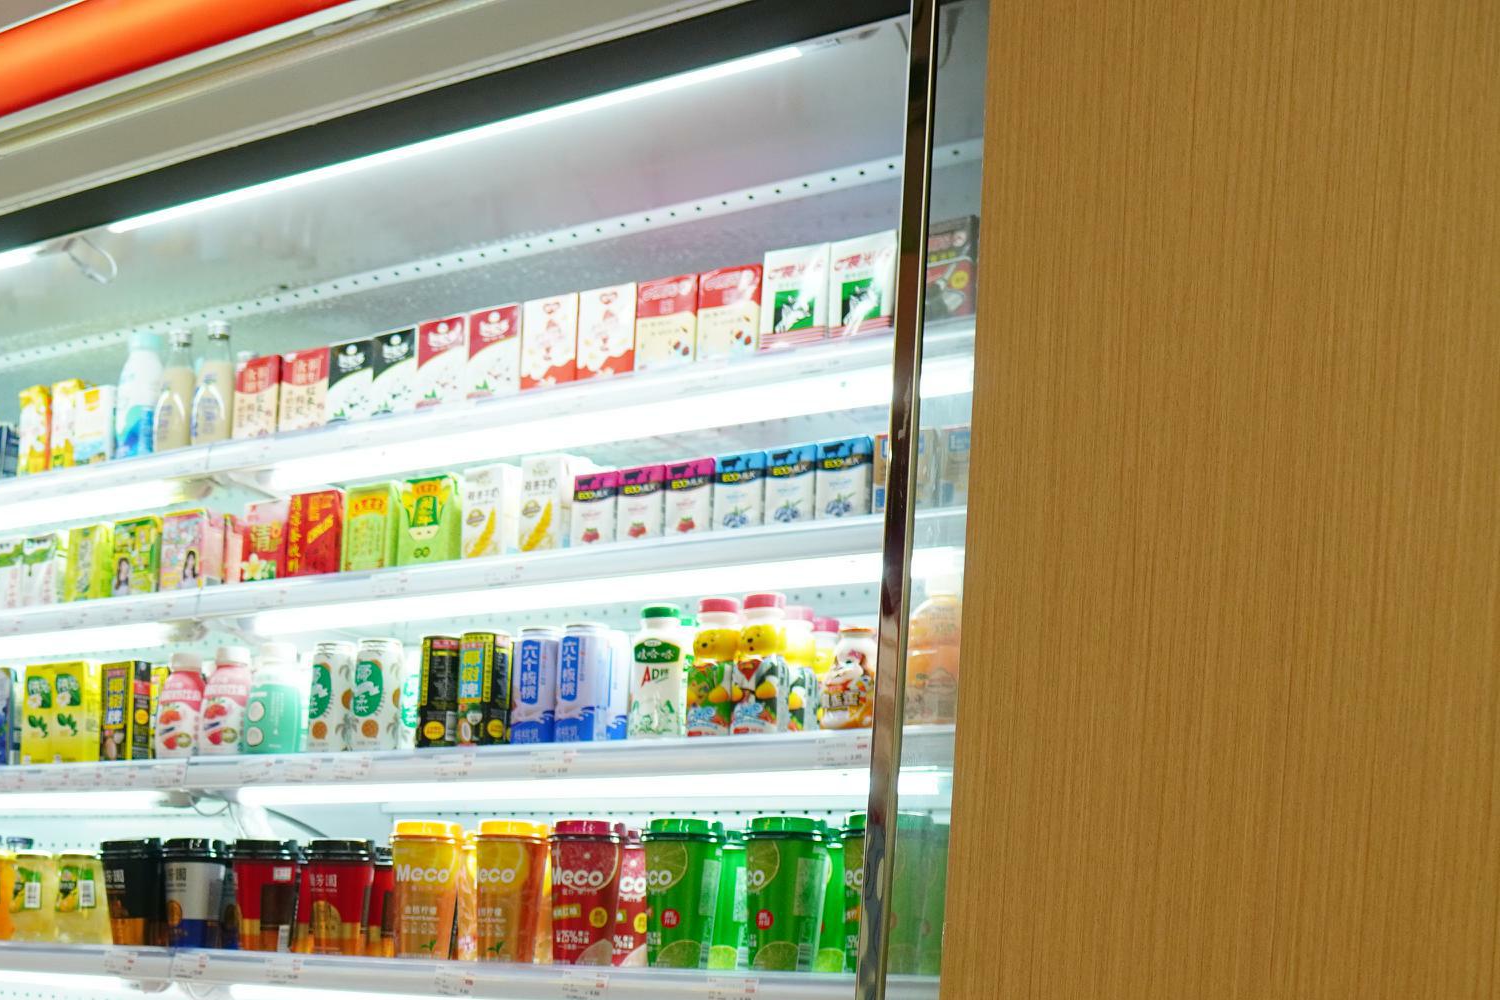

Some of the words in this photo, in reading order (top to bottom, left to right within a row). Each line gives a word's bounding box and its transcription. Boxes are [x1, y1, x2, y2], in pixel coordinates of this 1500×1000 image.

[522, 645, 538, 699] 六个核桃
[562, 641, 577, 696] 六个核桃
[397, 864, 449, 883] Meco
[477, 866, 515, 883] eco
